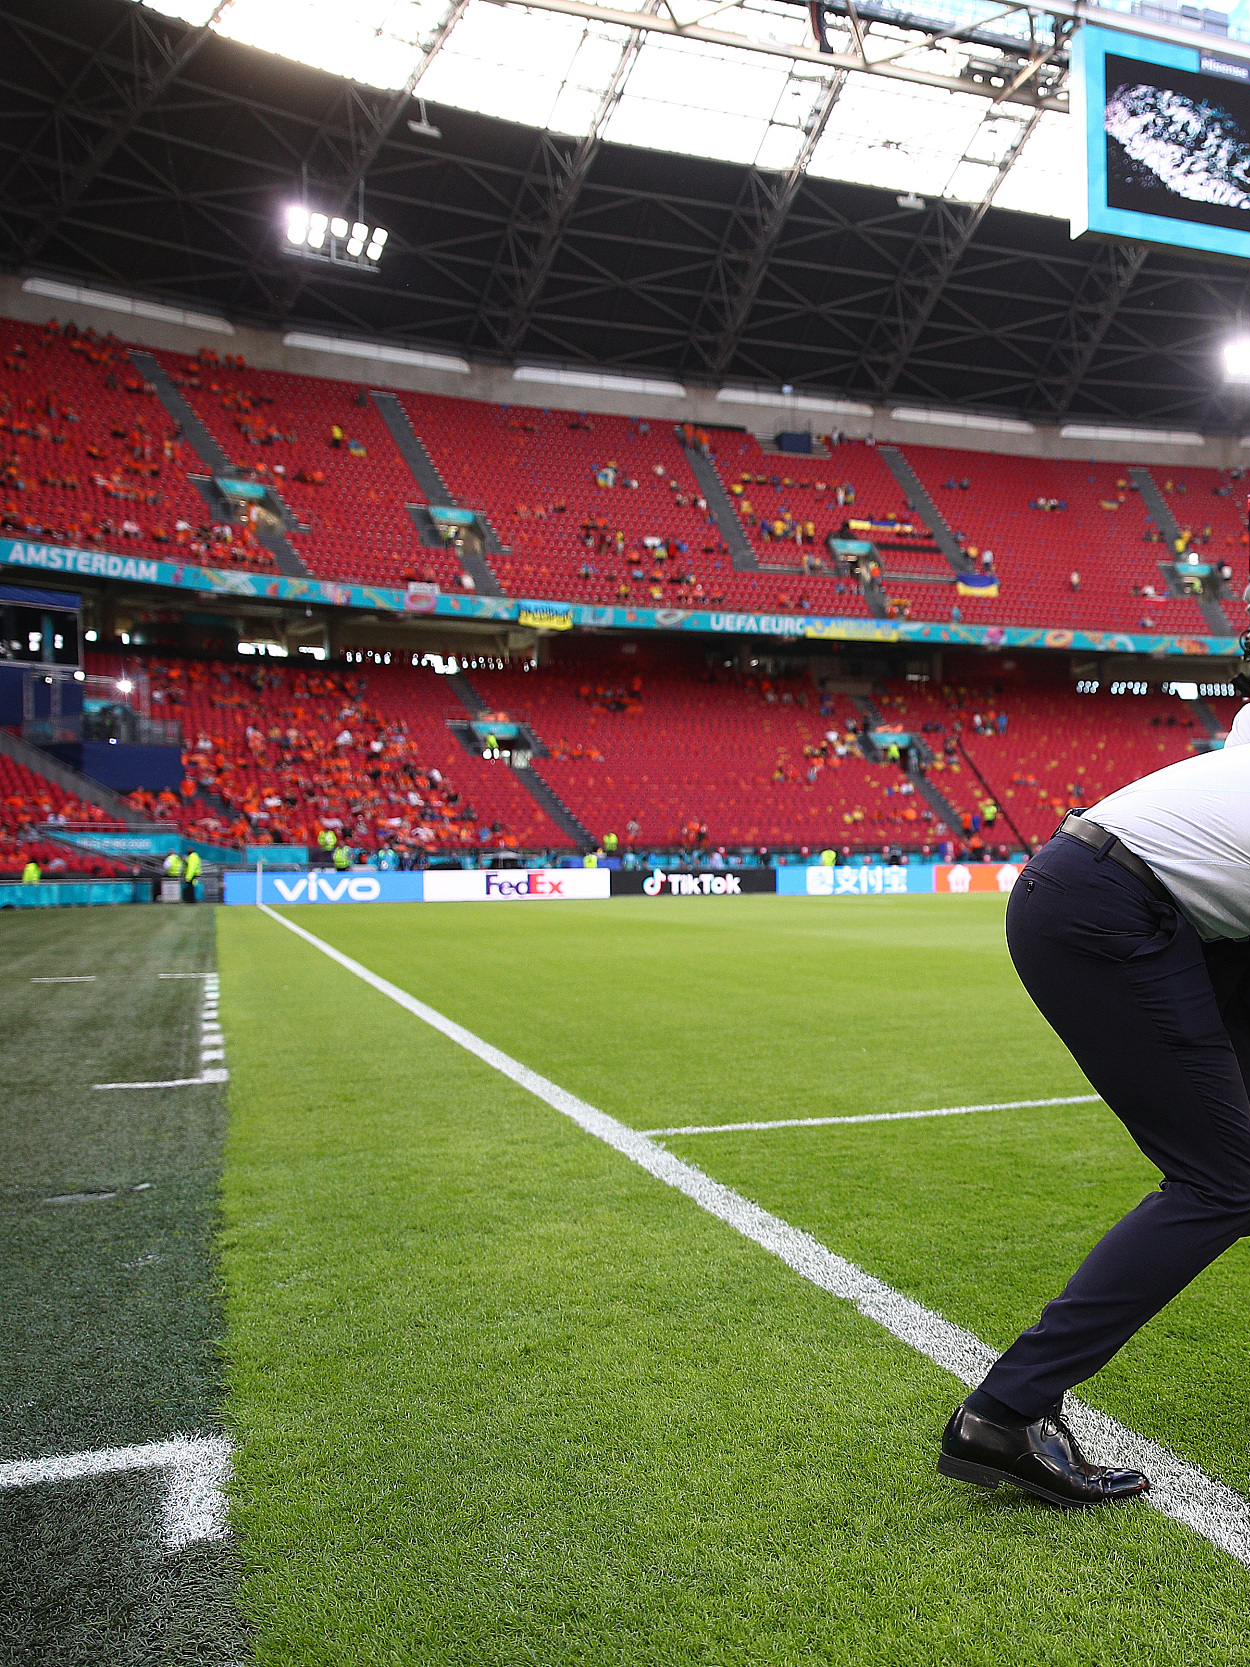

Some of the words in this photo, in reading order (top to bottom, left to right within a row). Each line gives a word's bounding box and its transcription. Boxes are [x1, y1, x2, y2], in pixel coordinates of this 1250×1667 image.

[8, 543, 157, 582] AMSTERDAM
[710, 613, 758, 633] UEFA
[273, 871, 380, 901] vivo
[485, 872, 564, 896] FedEx
[667, 873, 741, 895] TikTok
[834, 865, 907, 894] 支付宝
